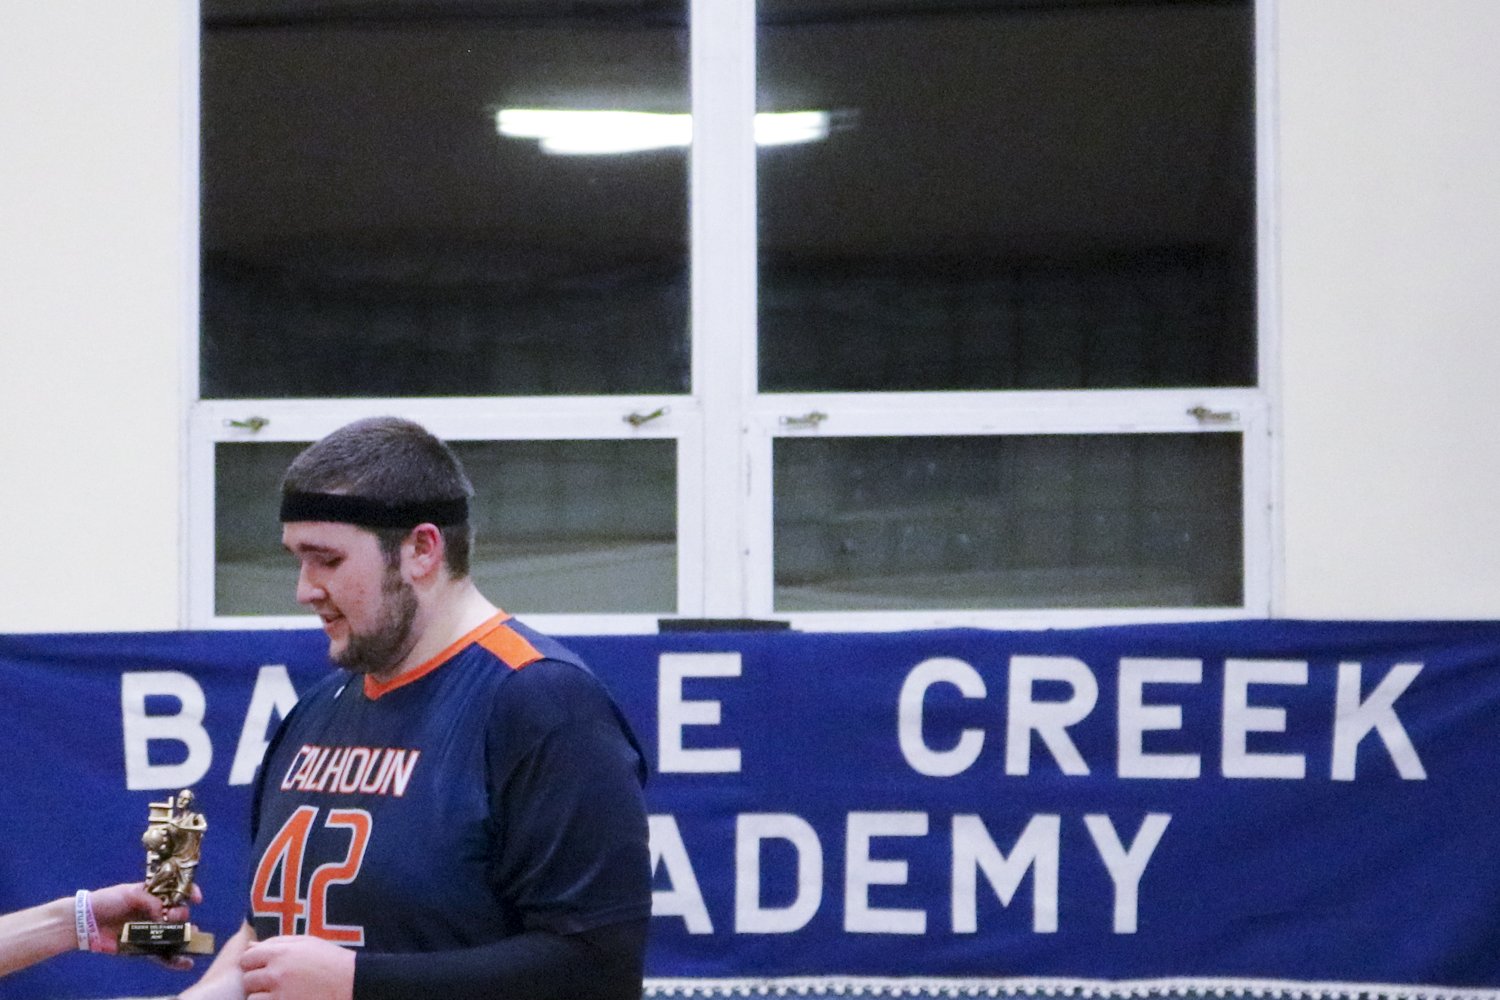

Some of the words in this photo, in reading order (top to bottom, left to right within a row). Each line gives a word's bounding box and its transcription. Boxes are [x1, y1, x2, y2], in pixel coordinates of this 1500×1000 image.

[280, 744, 421, 797] CALHOUN
[898, 655, 1427, 781] CREEK
[251, 805, 373, 947] 42
[650, 812, 1172, 935] ADEMY
